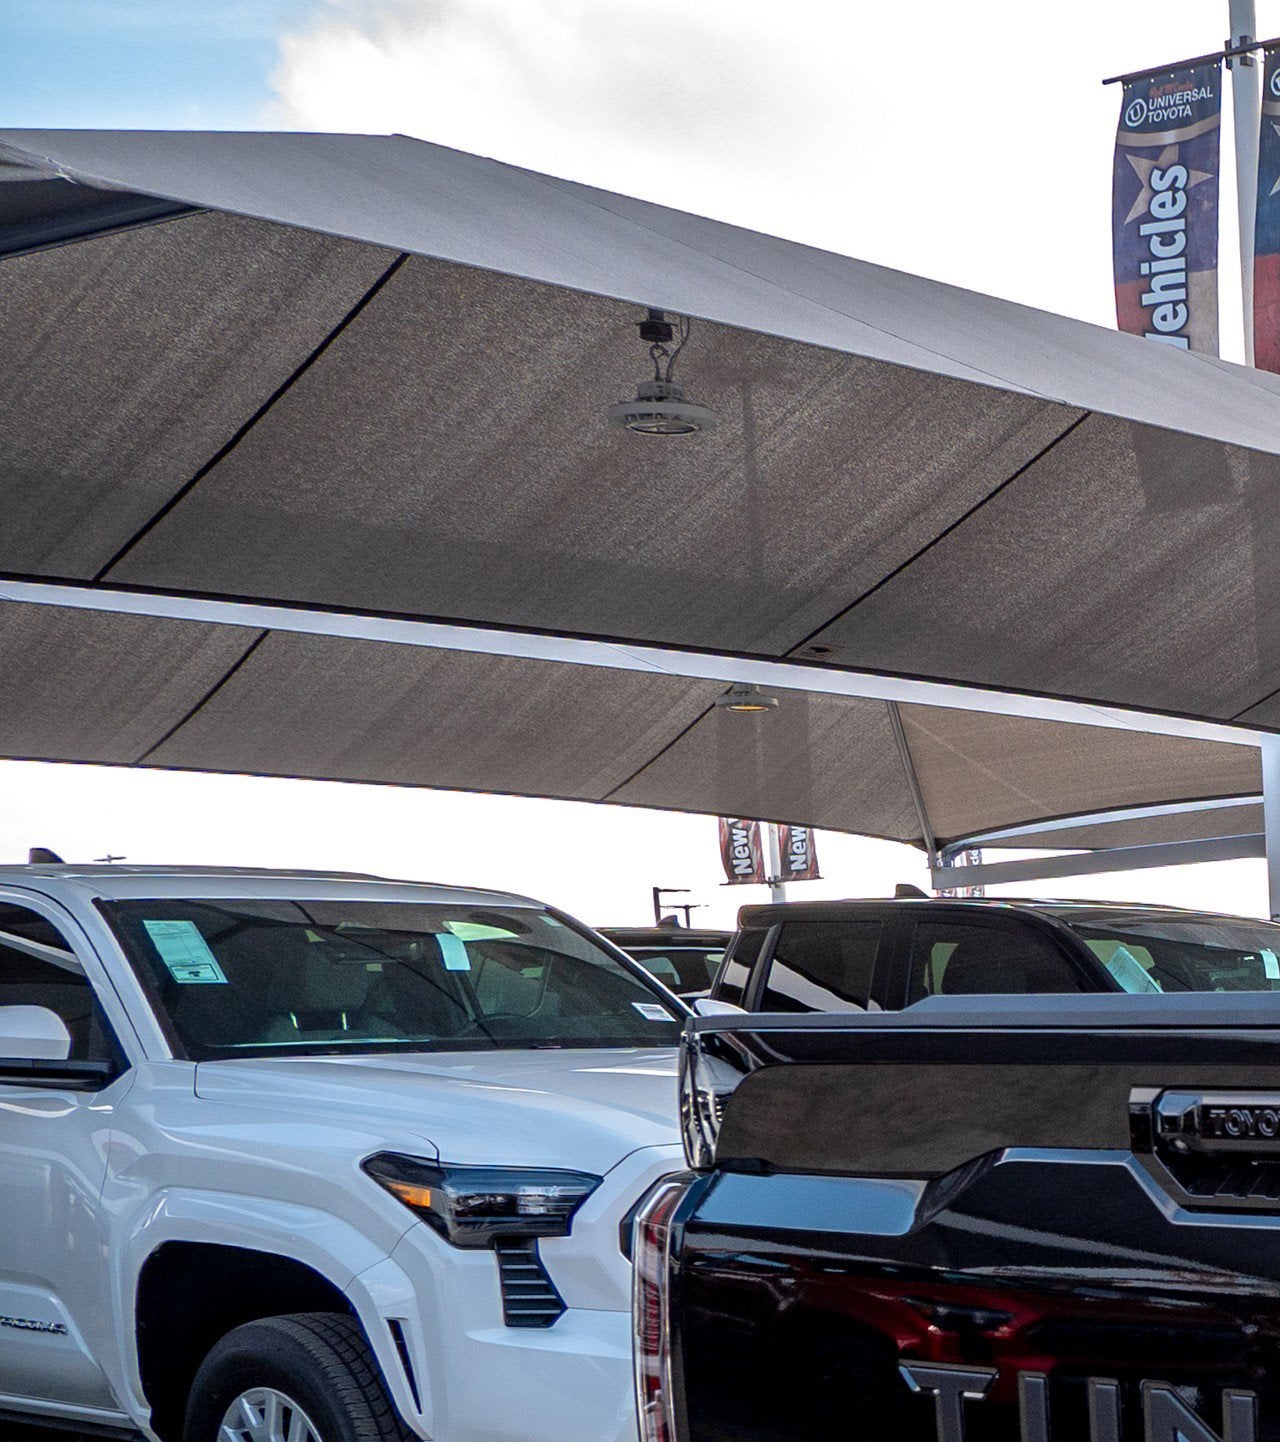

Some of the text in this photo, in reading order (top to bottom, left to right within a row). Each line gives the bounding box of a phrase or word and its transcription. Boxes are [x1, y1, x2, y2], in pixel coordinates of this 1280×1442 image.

[1147, 104, 1193, 123] TOYOTA
[1148, 86, 1214, 110] UNIVERSAL
[731, 828, 754, 875] New
[789, 826, 808, 871] New
